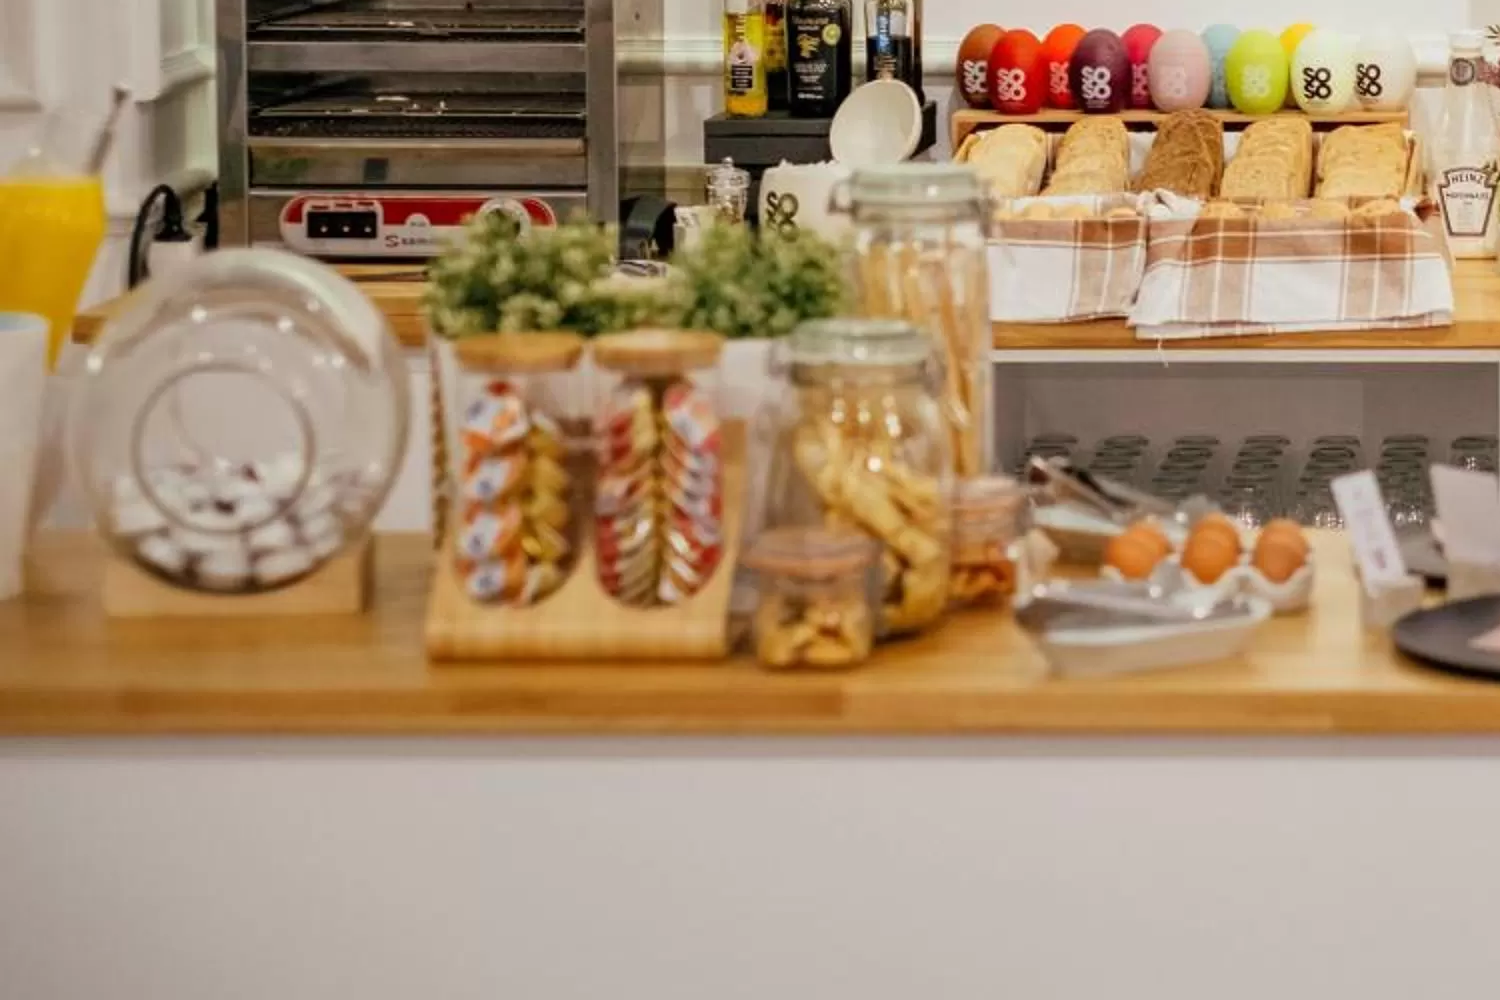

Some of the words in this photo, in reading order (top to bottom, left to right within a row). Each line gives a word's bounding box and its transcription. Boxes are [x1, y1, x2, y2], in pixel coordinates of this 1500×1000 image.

[1081, 66, 1111, 83] SO
[1303, 67, 1331, 83] SO
[1357, 63, 1381, 81] SO
[1451, 173, 1484, 184] HEINZ
[766, 190, 799, 216] SO
